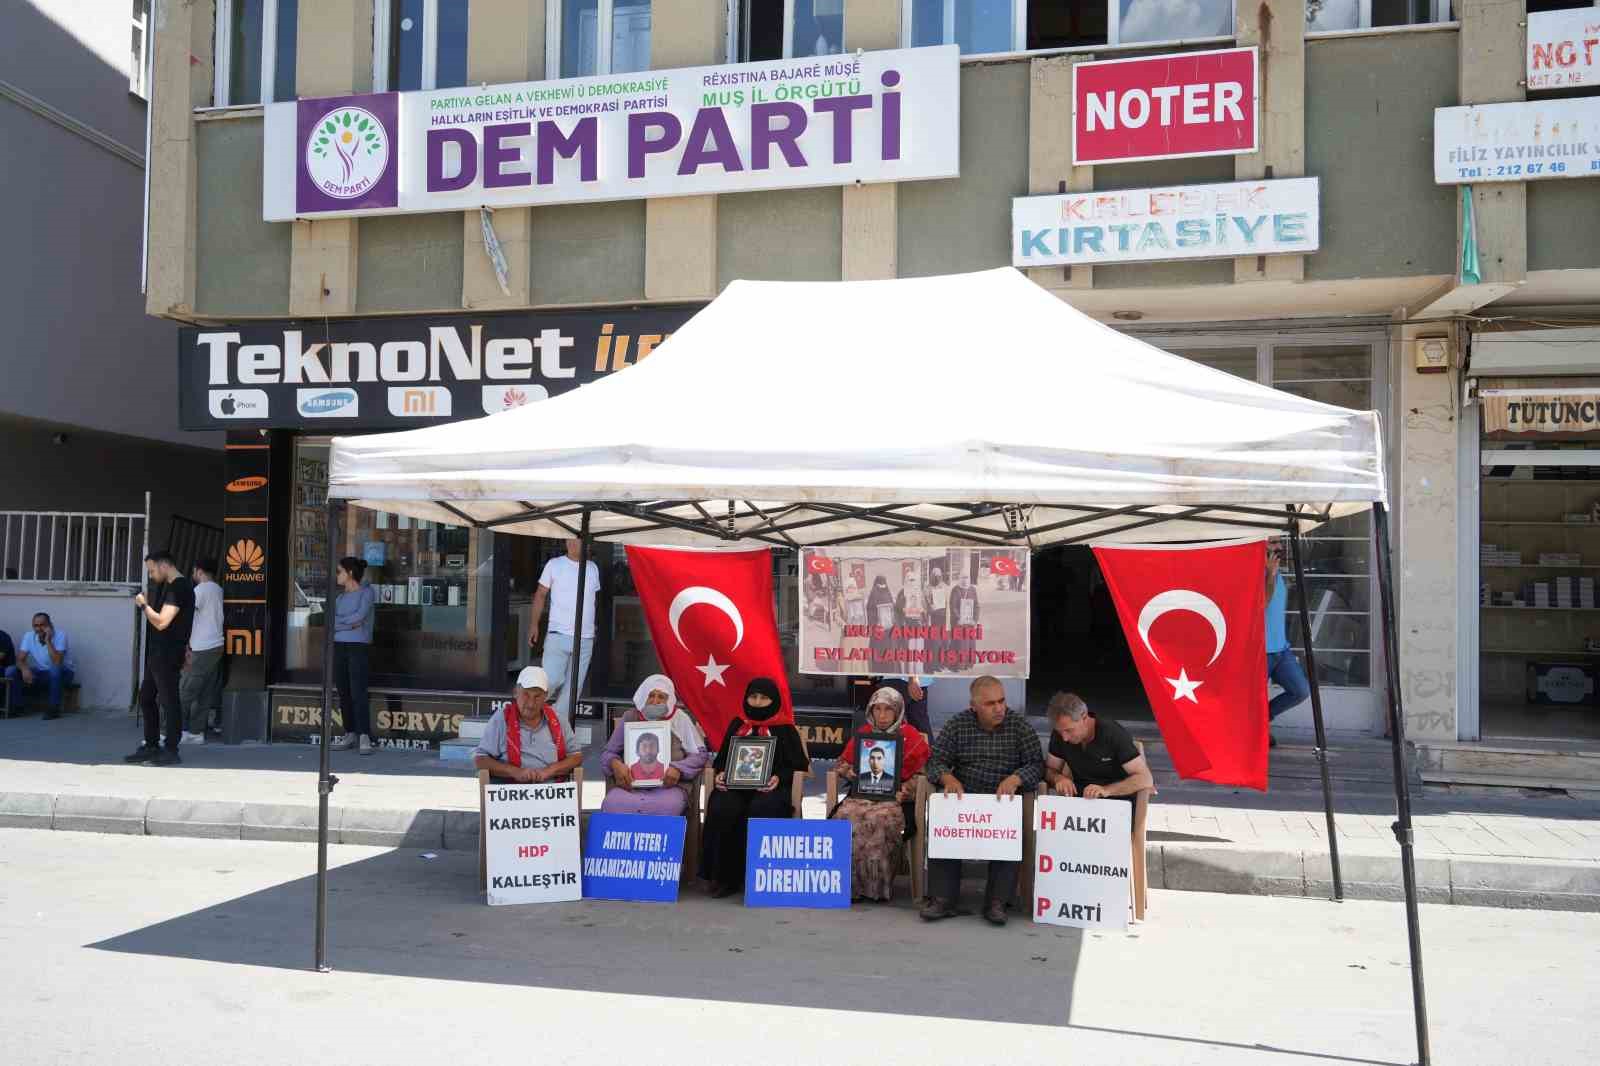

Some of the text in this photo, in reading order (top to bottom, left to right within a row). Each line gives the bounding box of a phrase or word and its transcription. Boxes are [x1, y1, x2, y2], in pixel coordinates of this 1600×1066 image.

[475, 95, 511, 106] GELAN
[516, 95, 524, 103] A
[703, 78, 861, 108] MUŞ İL ÖRGÜTÜ
[432, 94, 668, 126] HALKLARIN EŞİTLİK VE DEMOKRASİ PARTİSİ
[1086, 82, 1244, 131] NOTER
[427, 70, 901, 193] DEM PARTİ
[1449, 146, 1488, 163] FİLİZ
[1459, 167, 1482, 178] Tel
[1497, 164, 1521, 176] 212
[323, 180, 342, 193] DEM
[1021, 211, 1309, 257] KIRTASİYE
[197, 325, 576, 385] TeknoNet
[1508, 397, 1600, 424] TÜTÜNC
[226, 573, 264, 582] HUAWEI
[378, 738, 430, 751] TABLET
[488, 786, 575, 802] TÜRK-KÜRT
[489, 813, 576, 832] KARDEŞTİR
[958, 813, 992, 824] EVLAT
[602, 831, 632, 851] ARTIK
[634, 832, 662, 852] YETER
[934, 826, 1017, 840] NÖBETİNDEYİZ
[518, 845, 549, 858] HDP
[759, 836, 833, 860] ANNELER
[584, 857, 646, 880] YAKAMIZDAN
[1059, 862, 1128, 878] OLANDIRAN
[492, 870, 577, 889] KALLEŞTİR
[755, 863, 841, 894] DİRENİYOR
